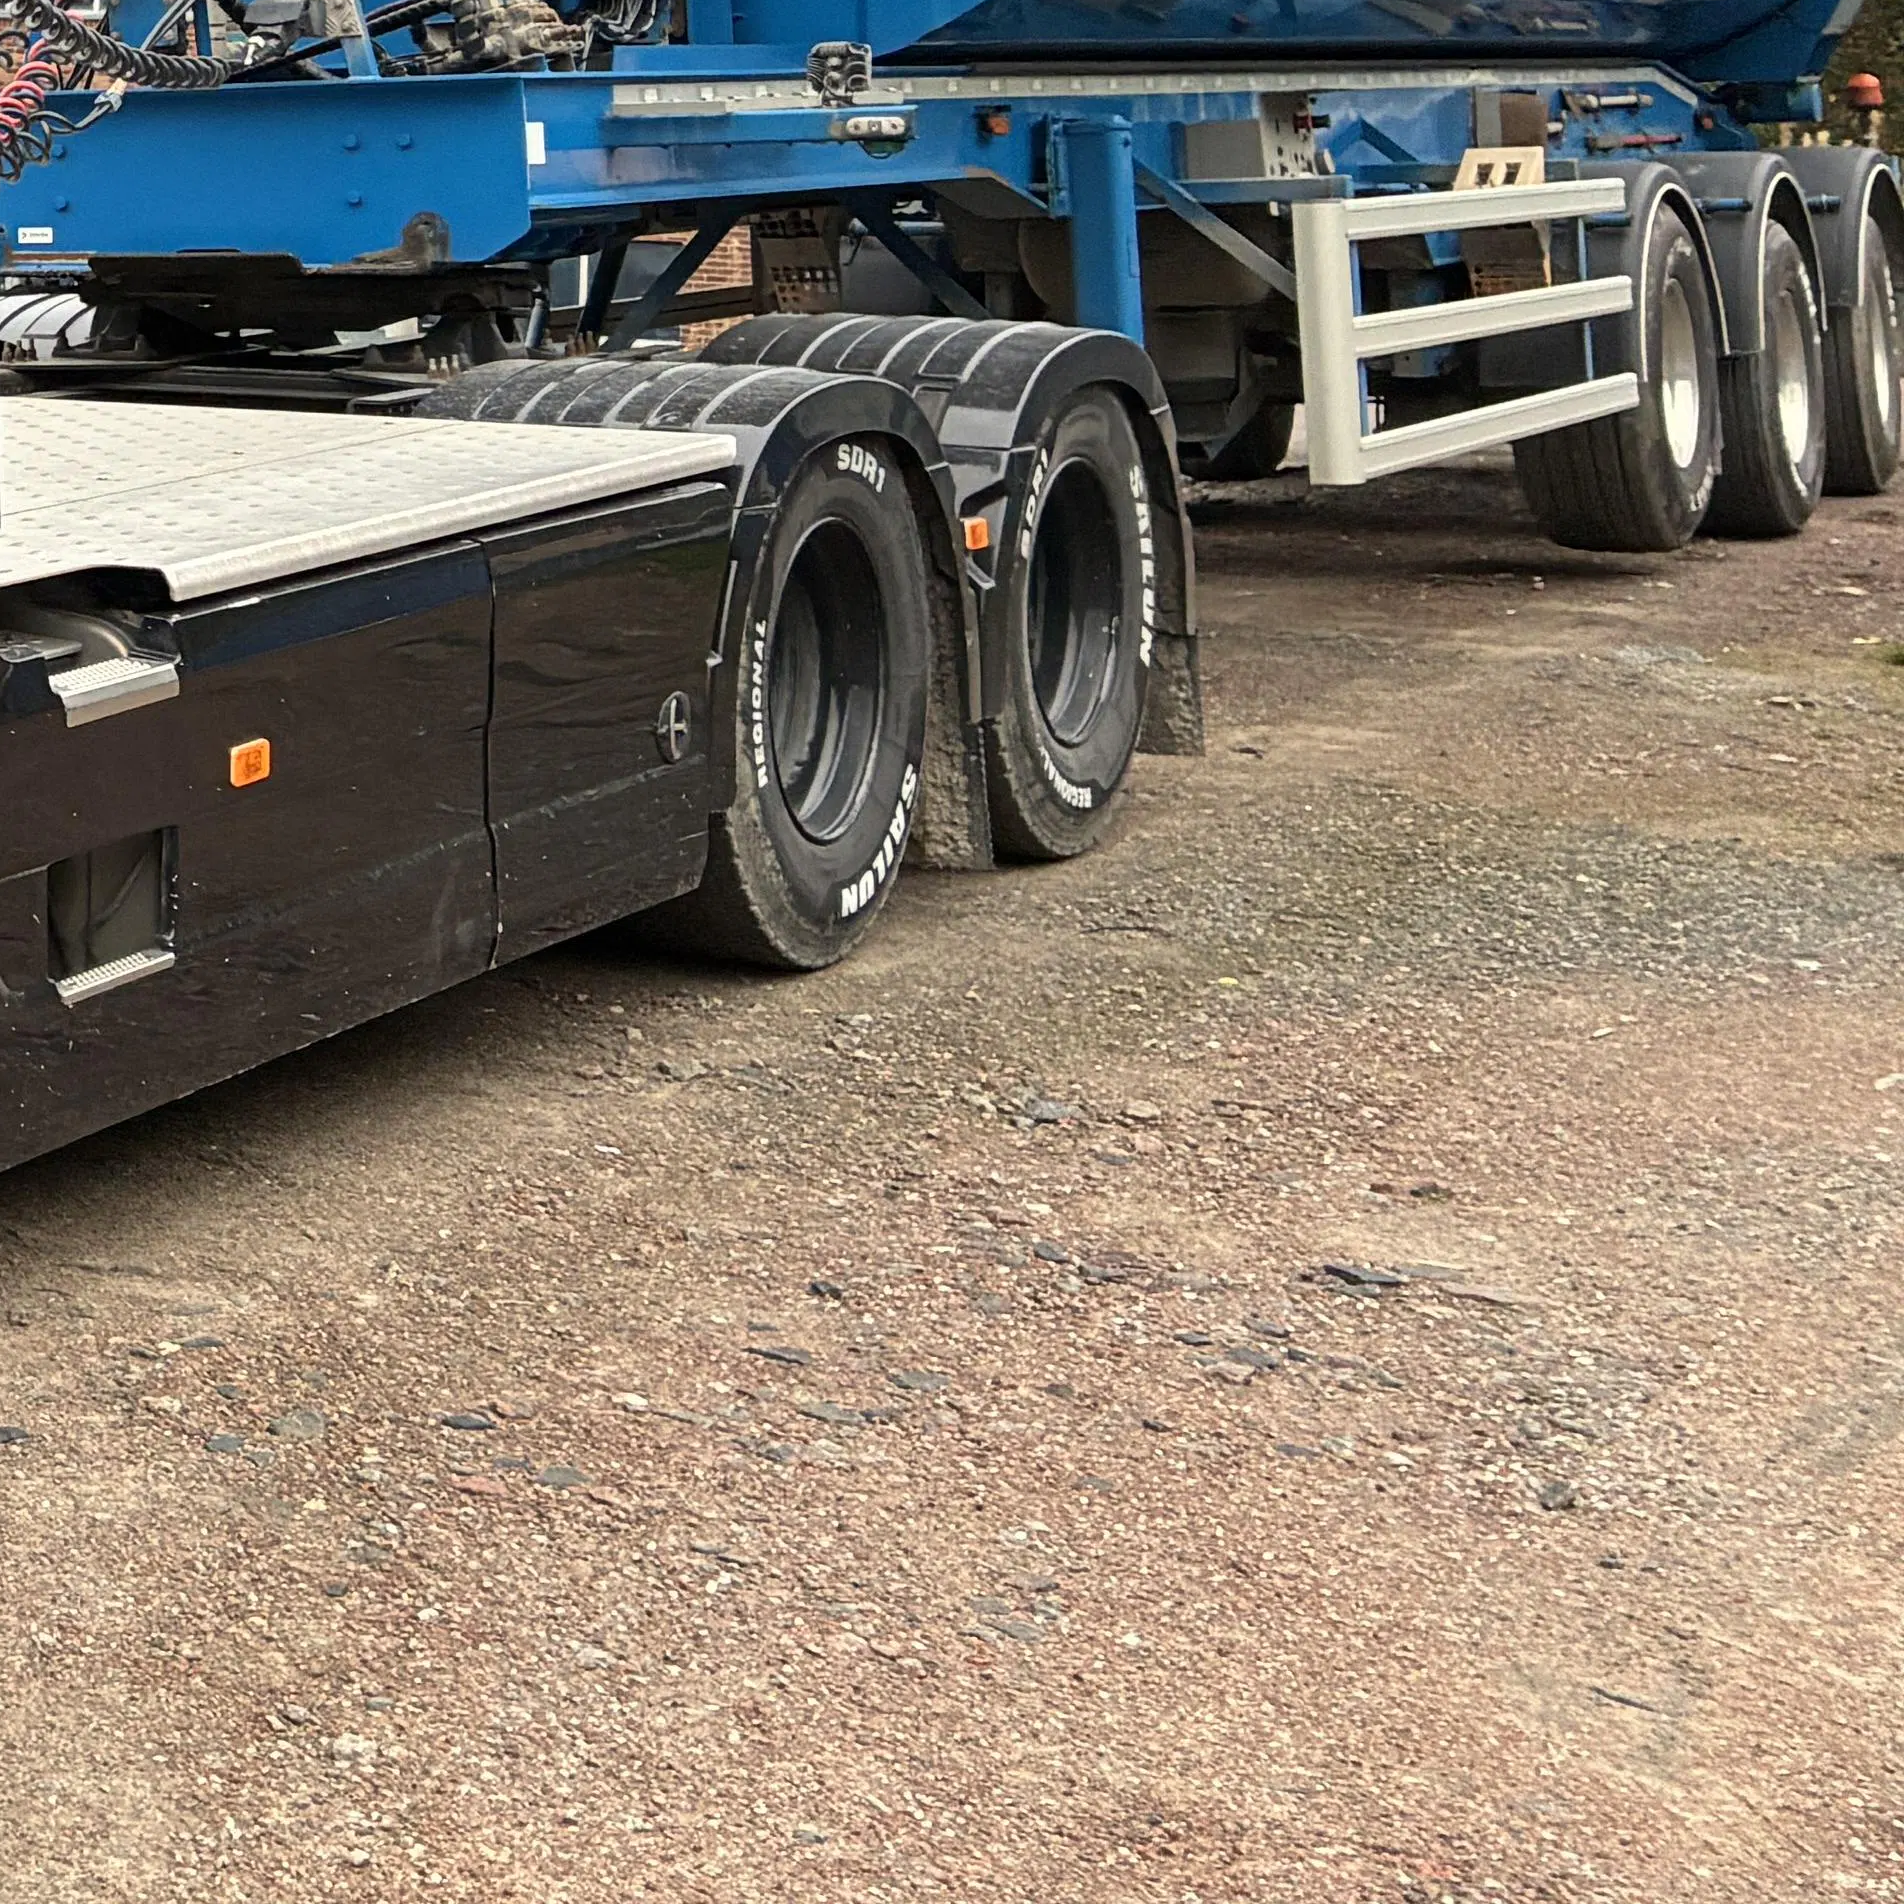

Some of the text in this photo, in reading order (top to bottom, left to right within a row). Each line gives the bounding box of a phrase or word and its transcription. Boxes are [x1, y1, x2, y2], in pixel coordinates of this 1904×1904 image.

[836, 442, 885, 493] SDR1
[1128, 464, 1156, 668] SAILUN
[750, 617, 769, 789] REGIONAL
[840, 762, 918, 919] SAILUN
